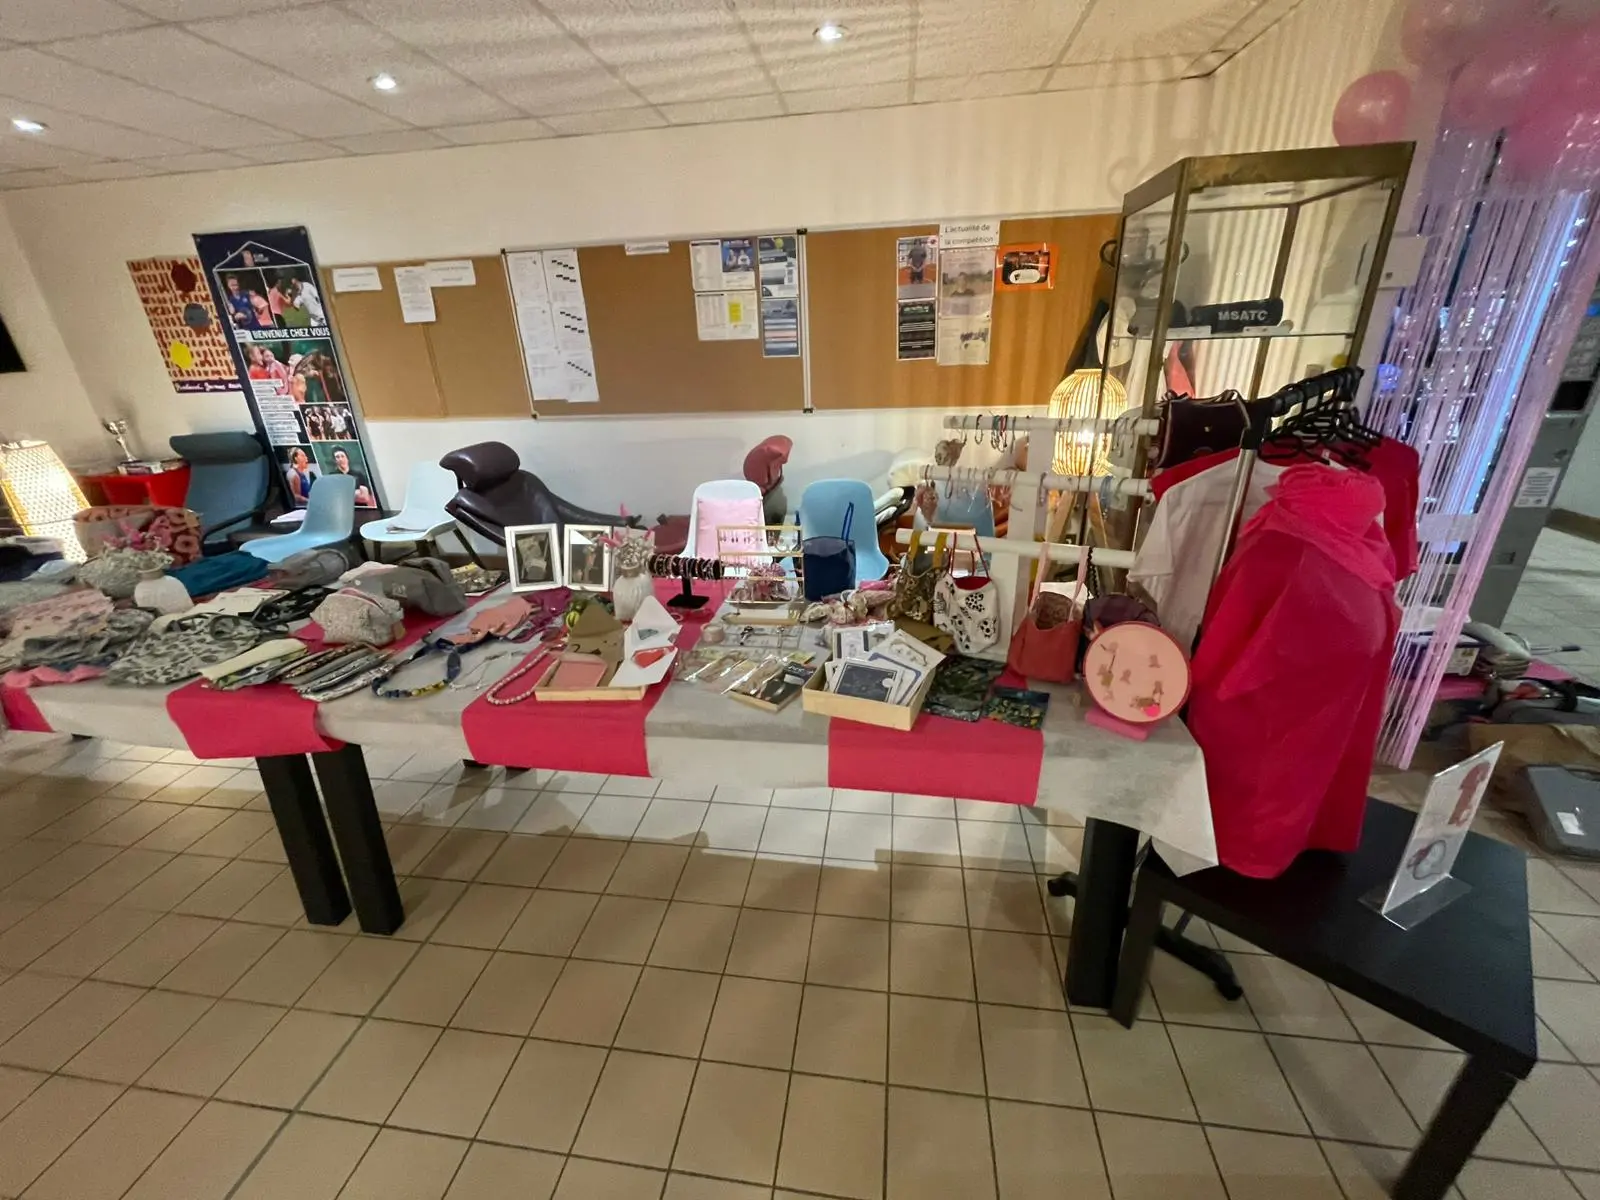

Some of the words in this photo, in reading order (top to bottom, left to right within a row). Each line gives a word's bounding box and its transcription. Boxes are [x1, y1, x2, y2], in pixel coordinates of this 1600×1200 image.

[1218, 310, 1268, 320] MSATC
[253, 329, 289, 339] BIENVENUE
[290, 328, 309, 337] CHEZ
[310, 327, 331, 336] VOUS
